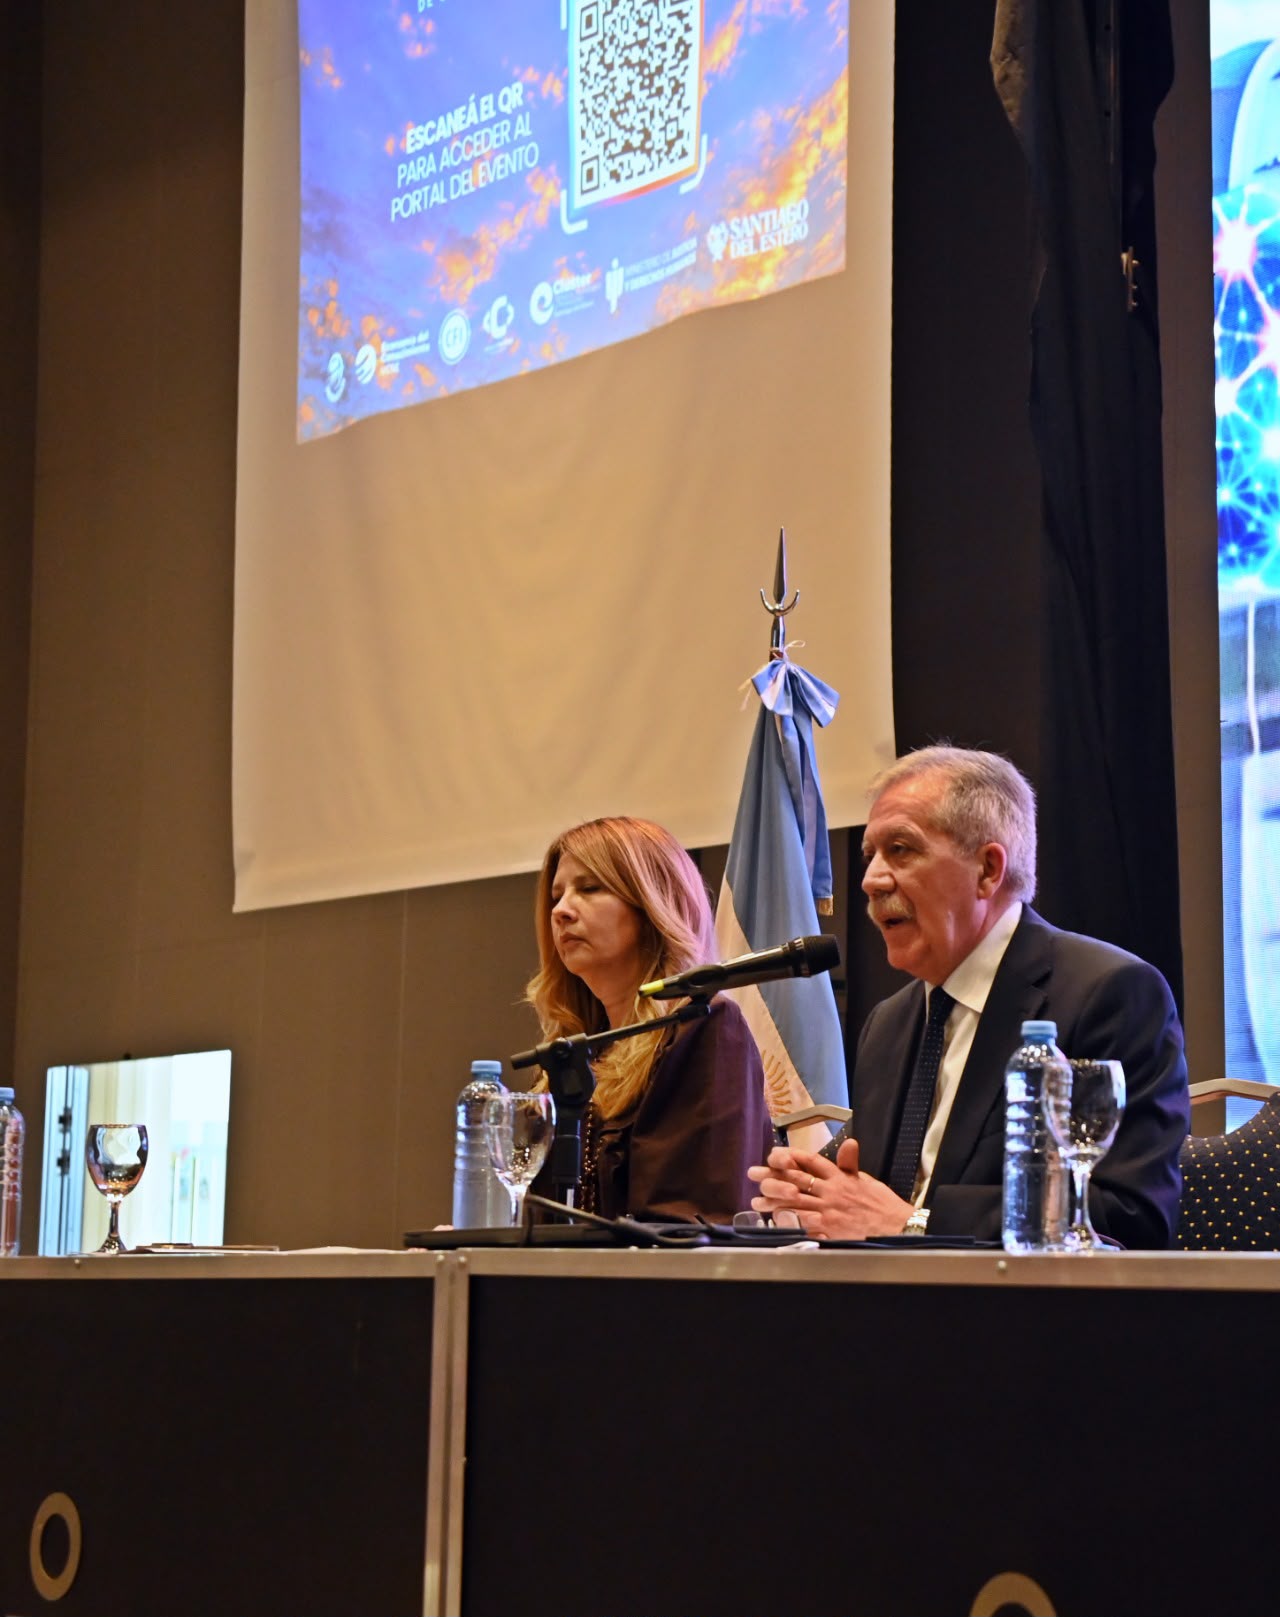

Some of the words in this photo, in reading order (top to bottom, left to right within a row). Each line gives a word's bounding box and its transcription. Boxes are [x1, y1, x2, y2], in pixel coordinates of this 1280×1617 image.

[397, 152, 437, 188] PARA
[439, 119, 511, 172] ACCEDER
[513, 112, 532, 140] AL
[406, 93, 479, 154] ESCANEÁ
[480, 93, 496, 122] EL
[498, 81, 524, 114] QR
[391, 180, 448, 222] PORTAL
[450, 168, 476, 200] DEL
[478, 141, 539, 188] EVENTO
[729, 198, 809, 239] SANTIAGO
[731, 236, 759, 259] DEL
[760, 221, 809, 253] ESTERO
